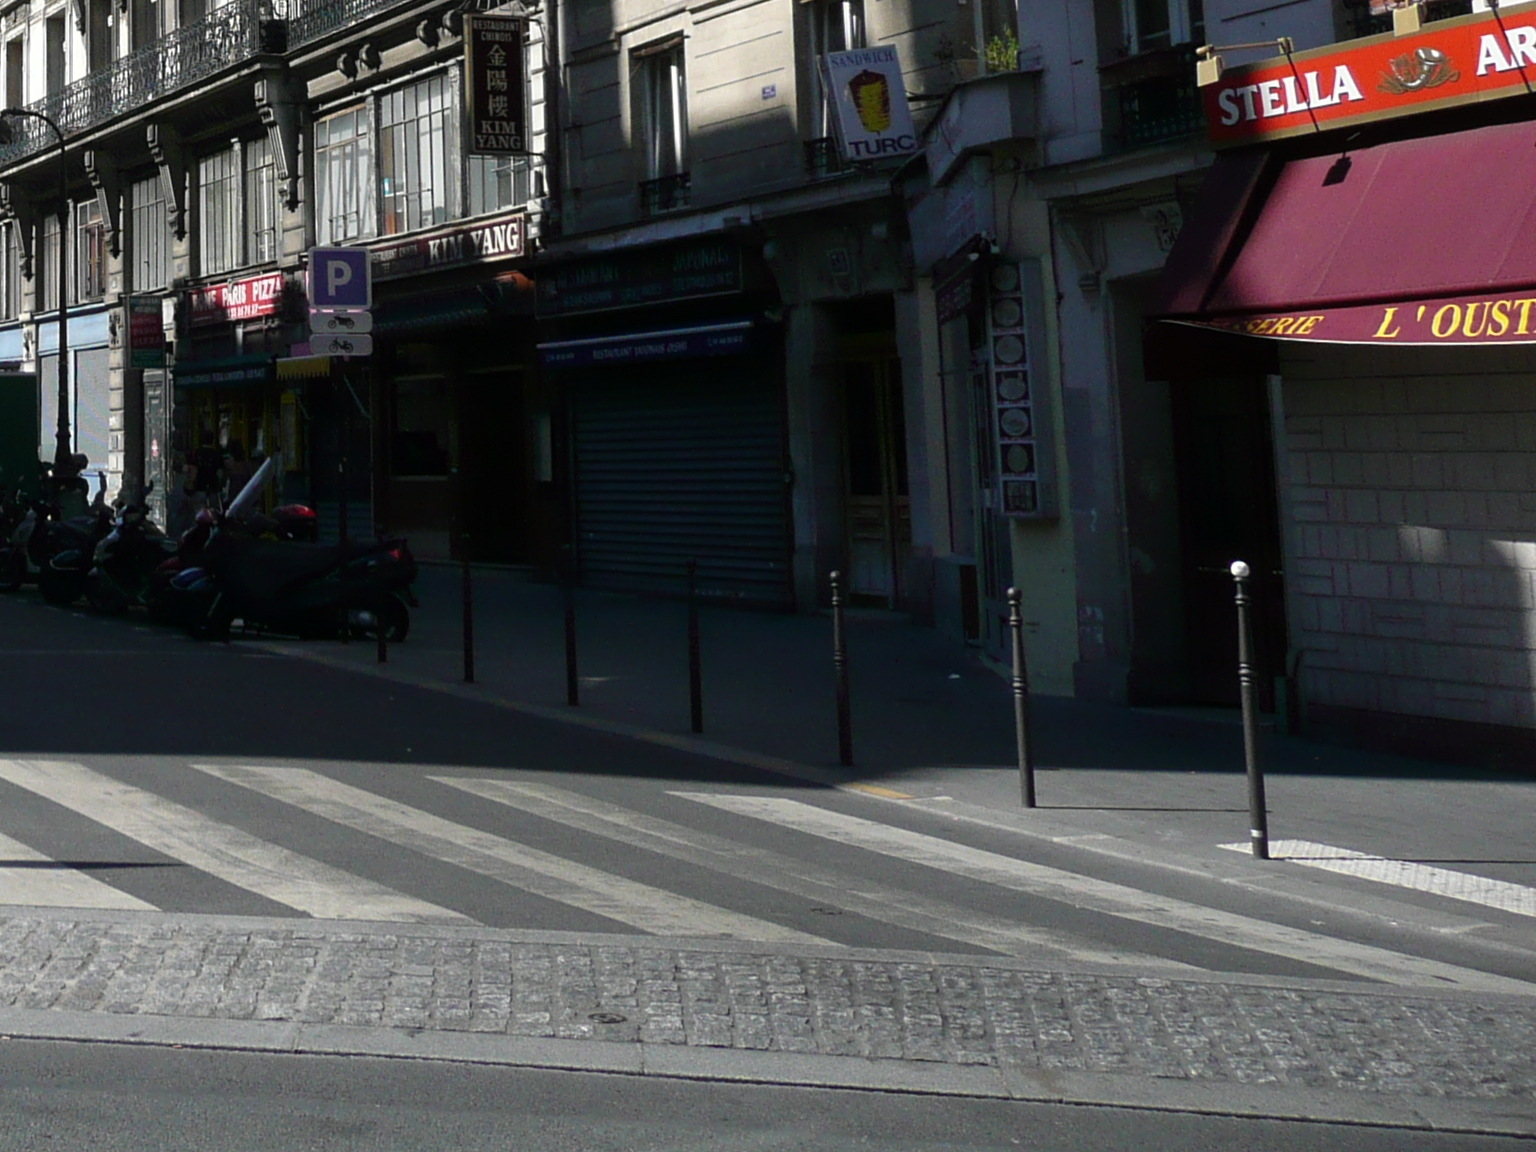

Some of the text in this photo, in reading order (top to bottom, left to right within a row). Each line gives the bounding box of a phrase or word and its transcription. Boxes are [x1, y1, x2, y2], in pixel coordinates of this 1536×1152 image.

[481, 31, 512, 42] CHINOIS
[831, 50, 894, 67] SANDWICH
[1217, 64, 1363, 126] STELLA
[480, 119, 516, 135] KIM
[476, 135, 521, 150] YANG
[848, 135, 914, 156] TURC
[428, 234, 464, 264] KIM
[470, 222, 520, 255] YANG
[252, 276, 282, 301] PIZZA
[327, 259, 353, 297] P
